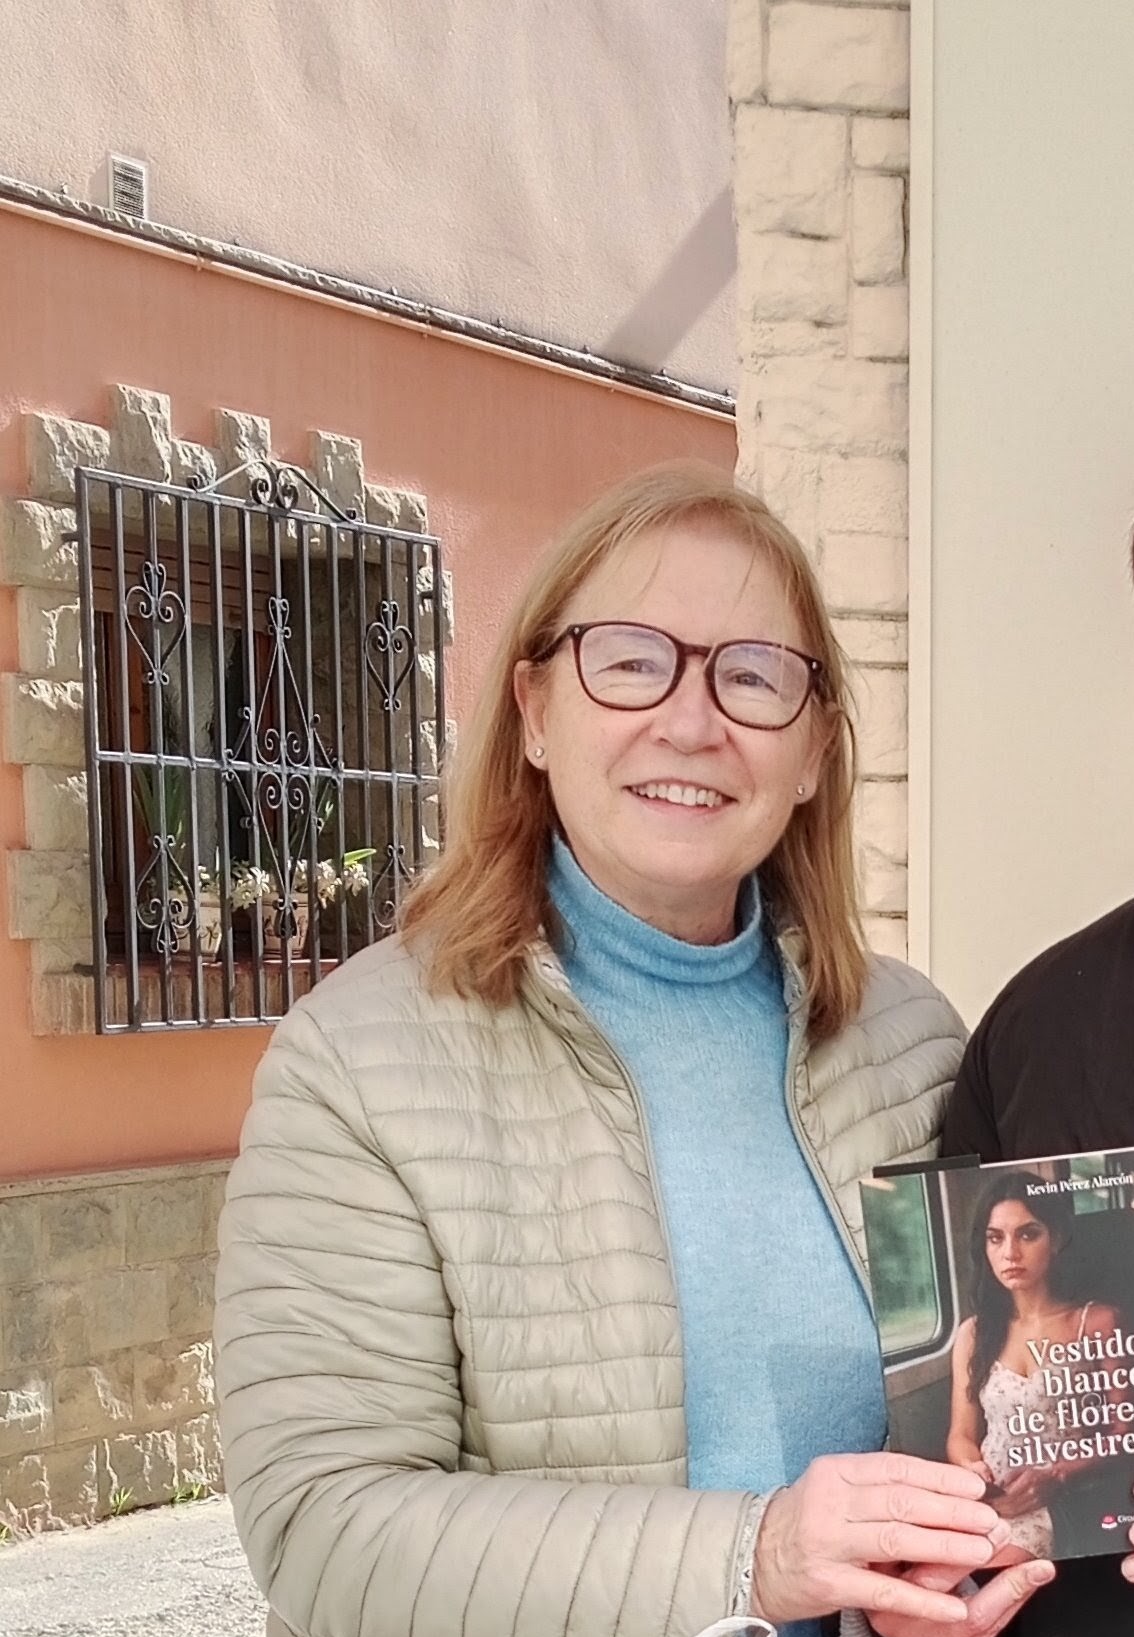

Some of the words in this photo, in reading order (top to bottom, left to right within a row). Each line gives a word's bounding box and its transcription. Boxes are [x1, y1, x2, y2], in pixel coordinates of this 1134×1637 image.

[1026, 1181, 1058, 1196] Kevin
[1060, 1178, 1090, 1193] Pérez
[1092, 1172, 1134, 1188] Alarcón
[1008, 1404, 1045, 1435] de
